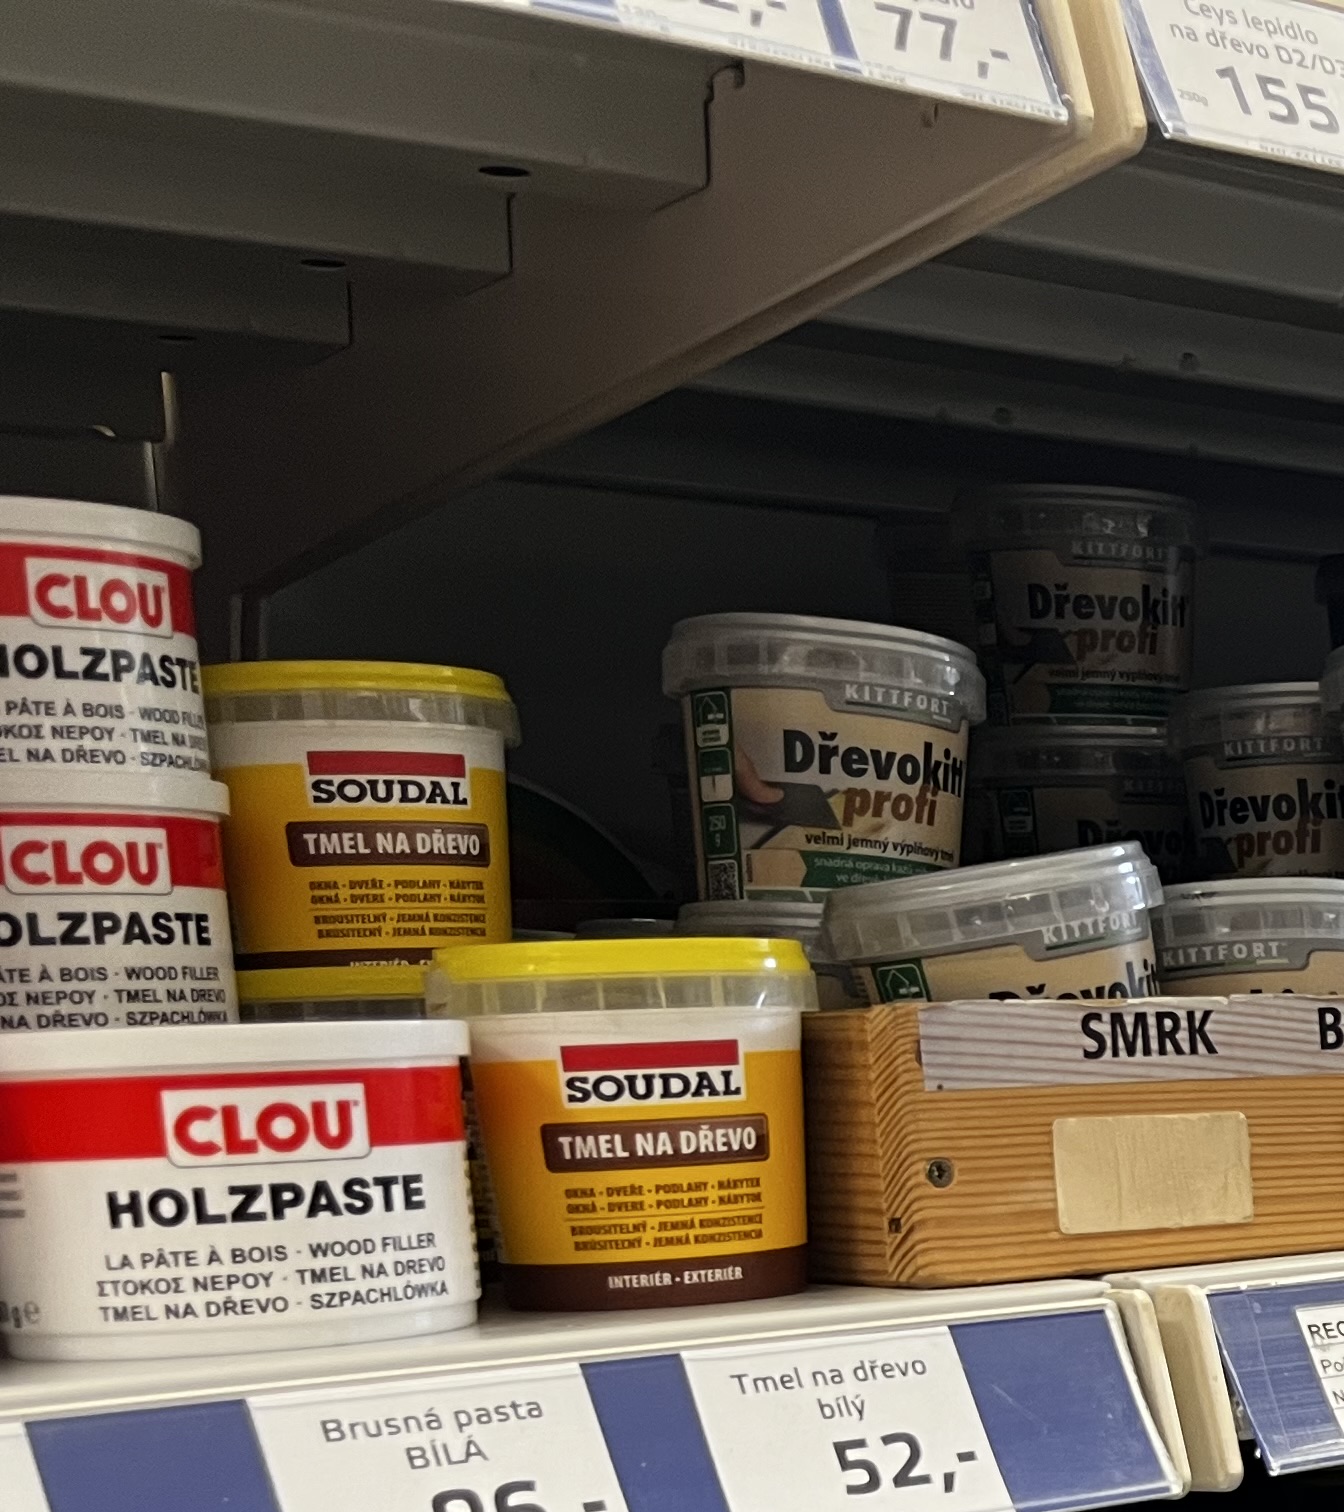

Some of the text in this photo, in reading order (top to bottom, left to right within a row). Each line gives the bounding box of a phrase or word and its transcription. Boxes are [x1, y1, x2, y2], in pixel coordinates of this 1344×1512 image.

[36, 573, 165, 628] CLOU
[843, 682, 951, 715] KITTFORT
[782, 728, 965, 798] Dřevokitt
[311, 775, 469, 807] SOUDAL
[841, 785, 941, 828] profi
[302, 826, 481, 857] TMEL NA DŘEVO
[10, 840, 163, 885] CLOU
[0, 912, 211, 946] OLZPASTE
[1163, 941, 1283, 968] KITTFORT
[1081, 1008, 1219, 1060] SMRK
[565, 1068, 742, 1104] SOUDAL
[171, 1099, 361, 1155] CLOU
[558, 1123, 757, 1160] TMEL NA DŘEVO
[106, 1173, 426, 1230] HOLZPASTE
[105, 1232, 438, 1272] LA PÂTE À BOIS WOOD FILLER
[295, 1255, 446, 1285] TMEL NA DREVO
[608, 1266, 743, 1289] INTERIÉR EXTERIÉR
[98, 1279, 449, 1323] TMEL NA DŘEVO SZPACHLÓWKA
[730, 1357, 927, 1396] Tmel na dřevo
[320, 1399, 544, 1445] Brusná pasta
[817, 1393, 866, 1422] bílý
[404, 1436, 490, 1472] BÍLÁ
[832, 1432, 979, 1496] 52,-
